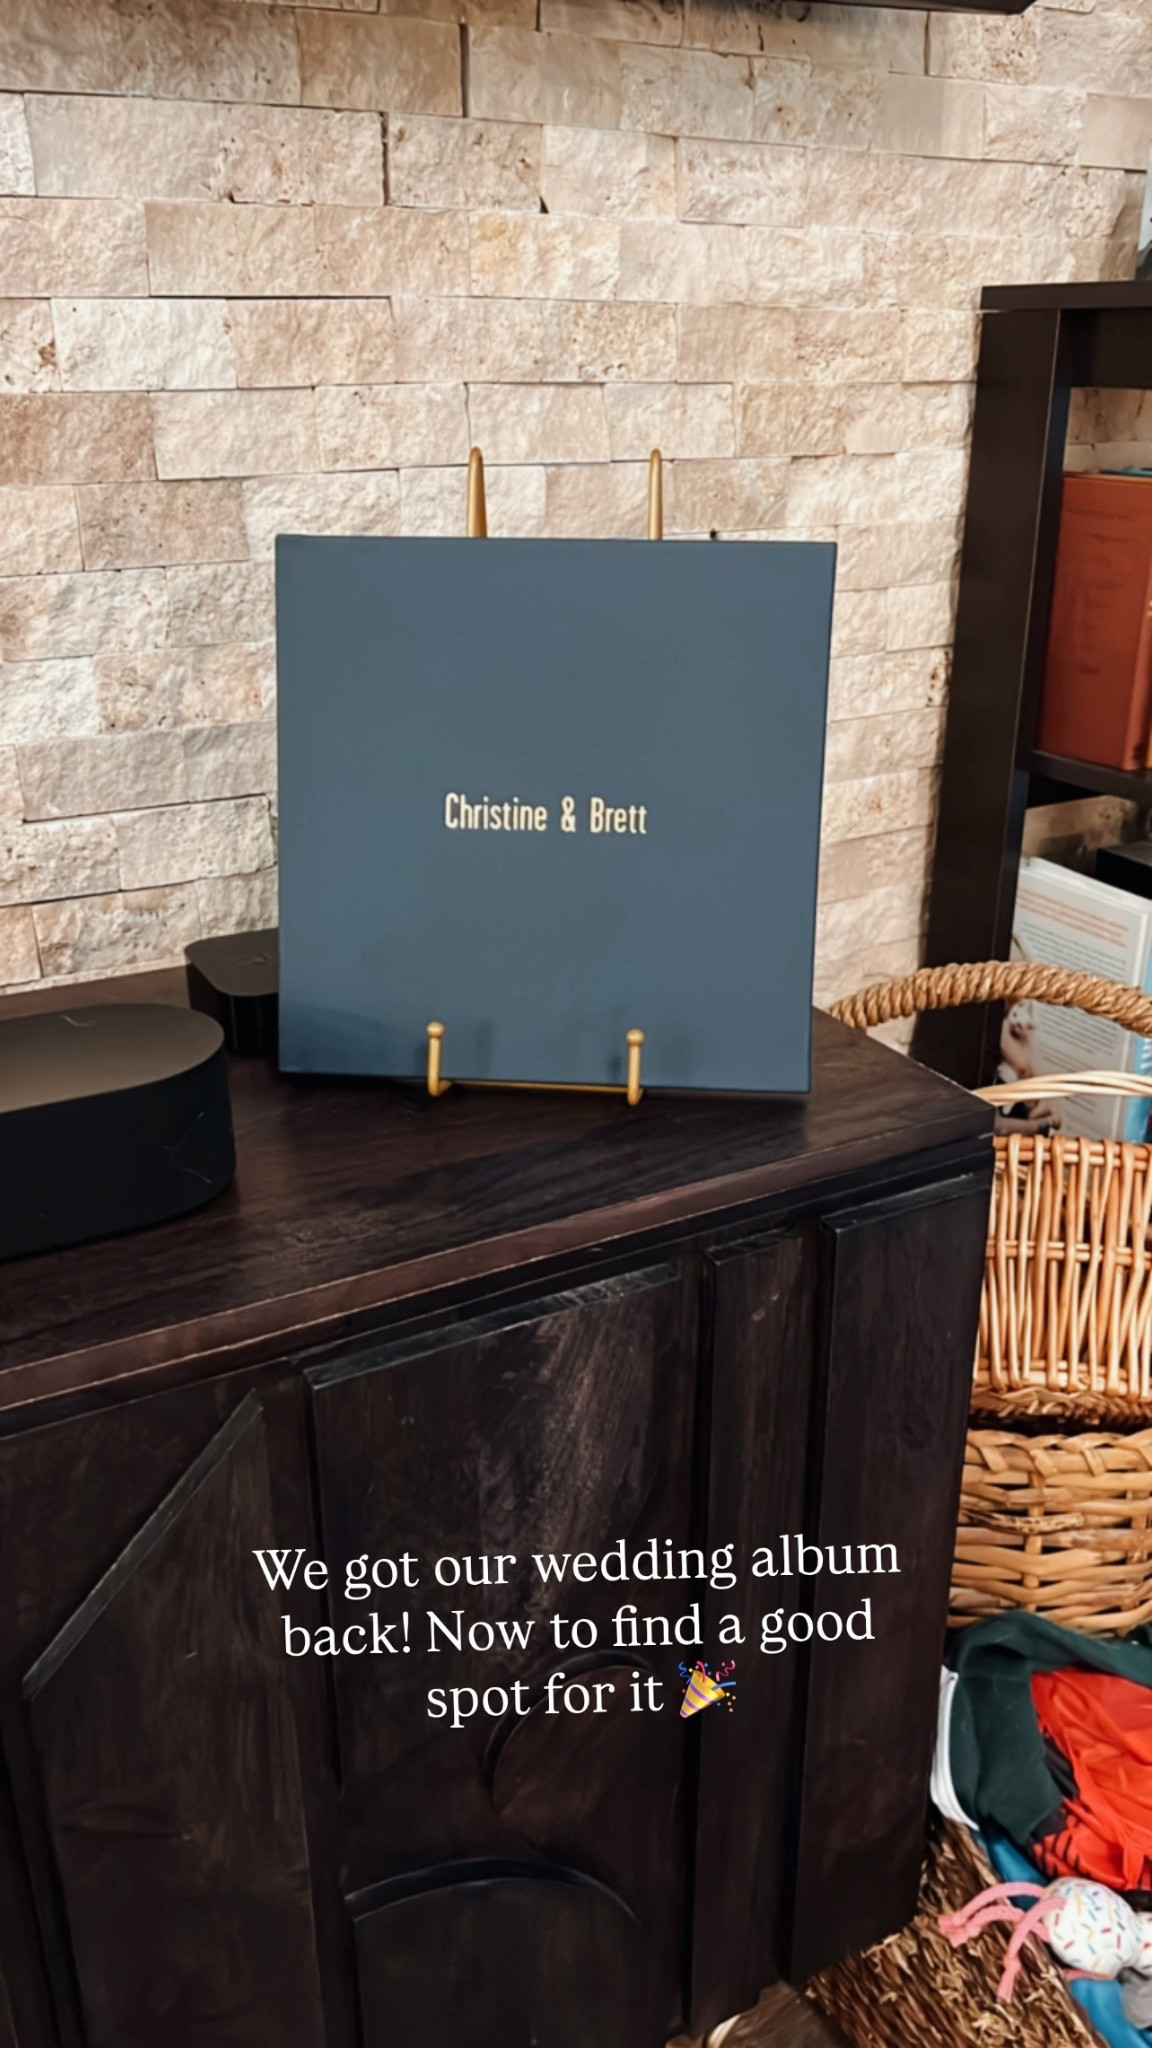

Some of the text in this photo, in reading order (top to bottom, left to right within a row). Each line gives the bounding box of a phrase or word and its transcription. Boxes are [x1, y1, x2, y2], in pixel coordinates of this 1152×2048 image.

[445, 792, 648, 835] Christine & Brett
